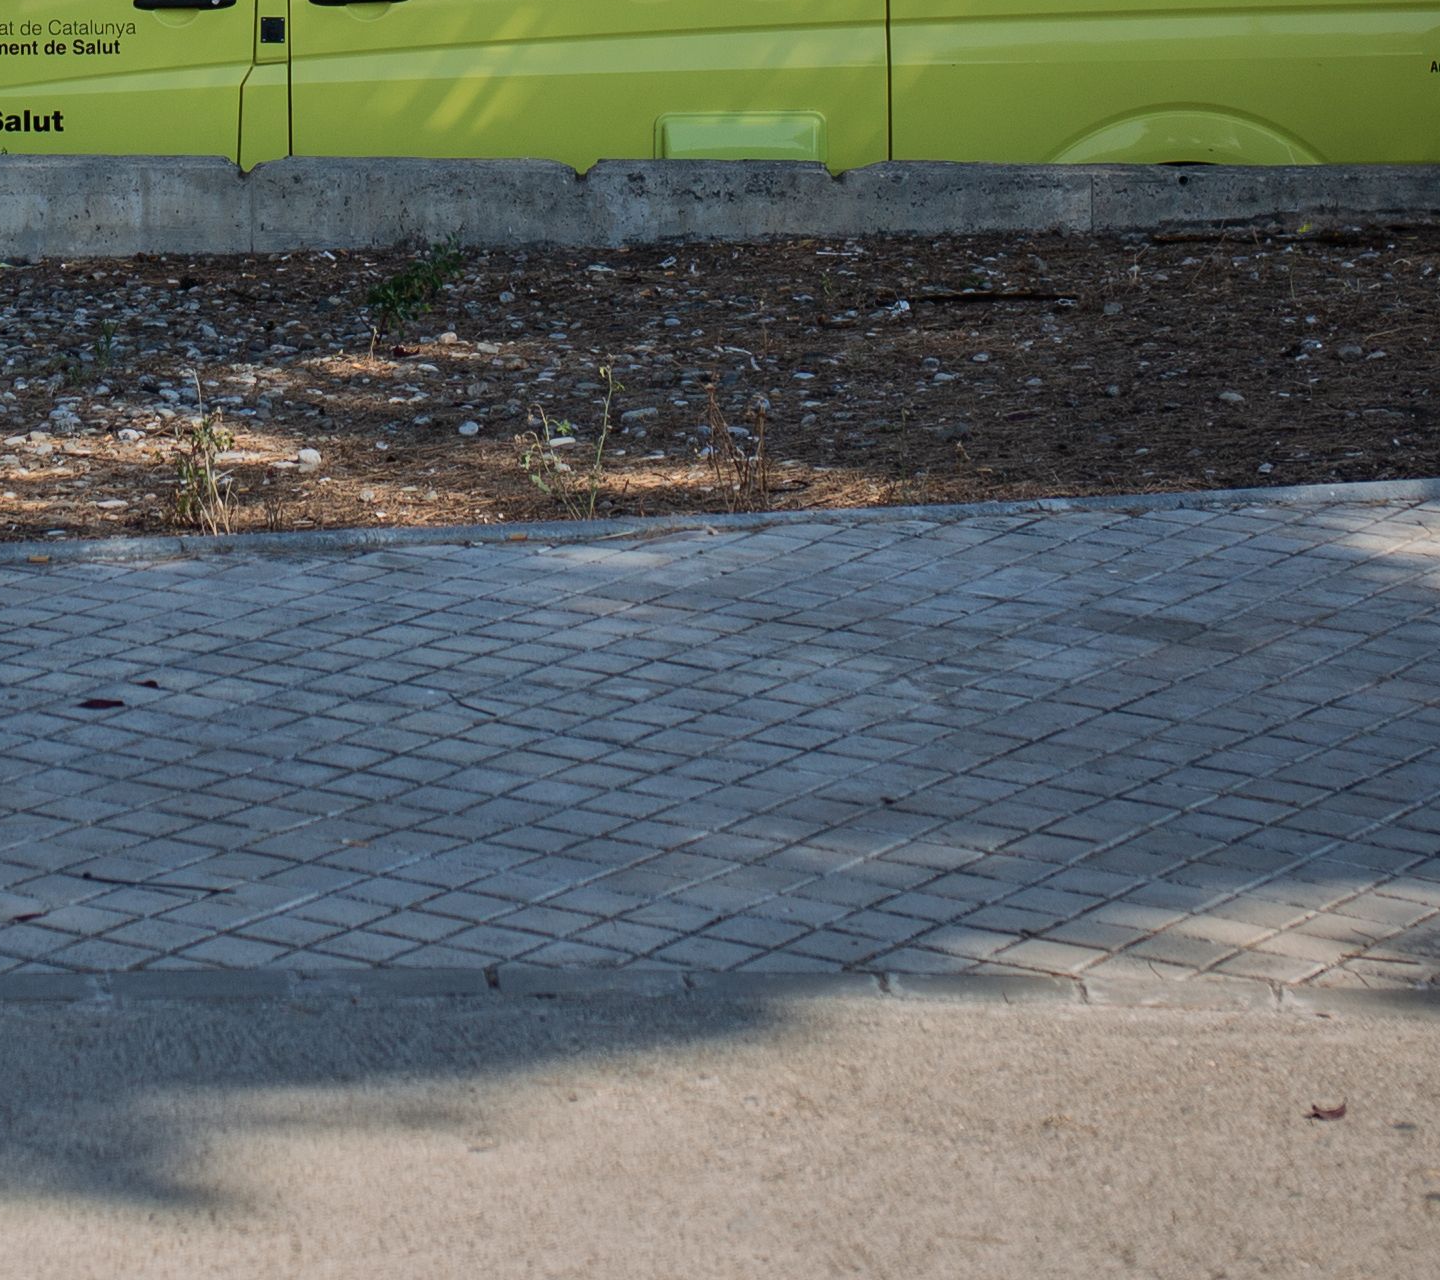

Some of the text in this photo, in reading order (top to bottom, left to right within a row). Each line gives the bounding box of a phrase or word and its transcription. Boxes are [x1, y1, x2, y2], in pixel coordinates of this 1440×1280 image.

[18, 19, 43, 37] de
[47, 19, 137, 39] Catalunya
[43, 39, 68, 56] de
[72, 39, 121, 56] Salut
